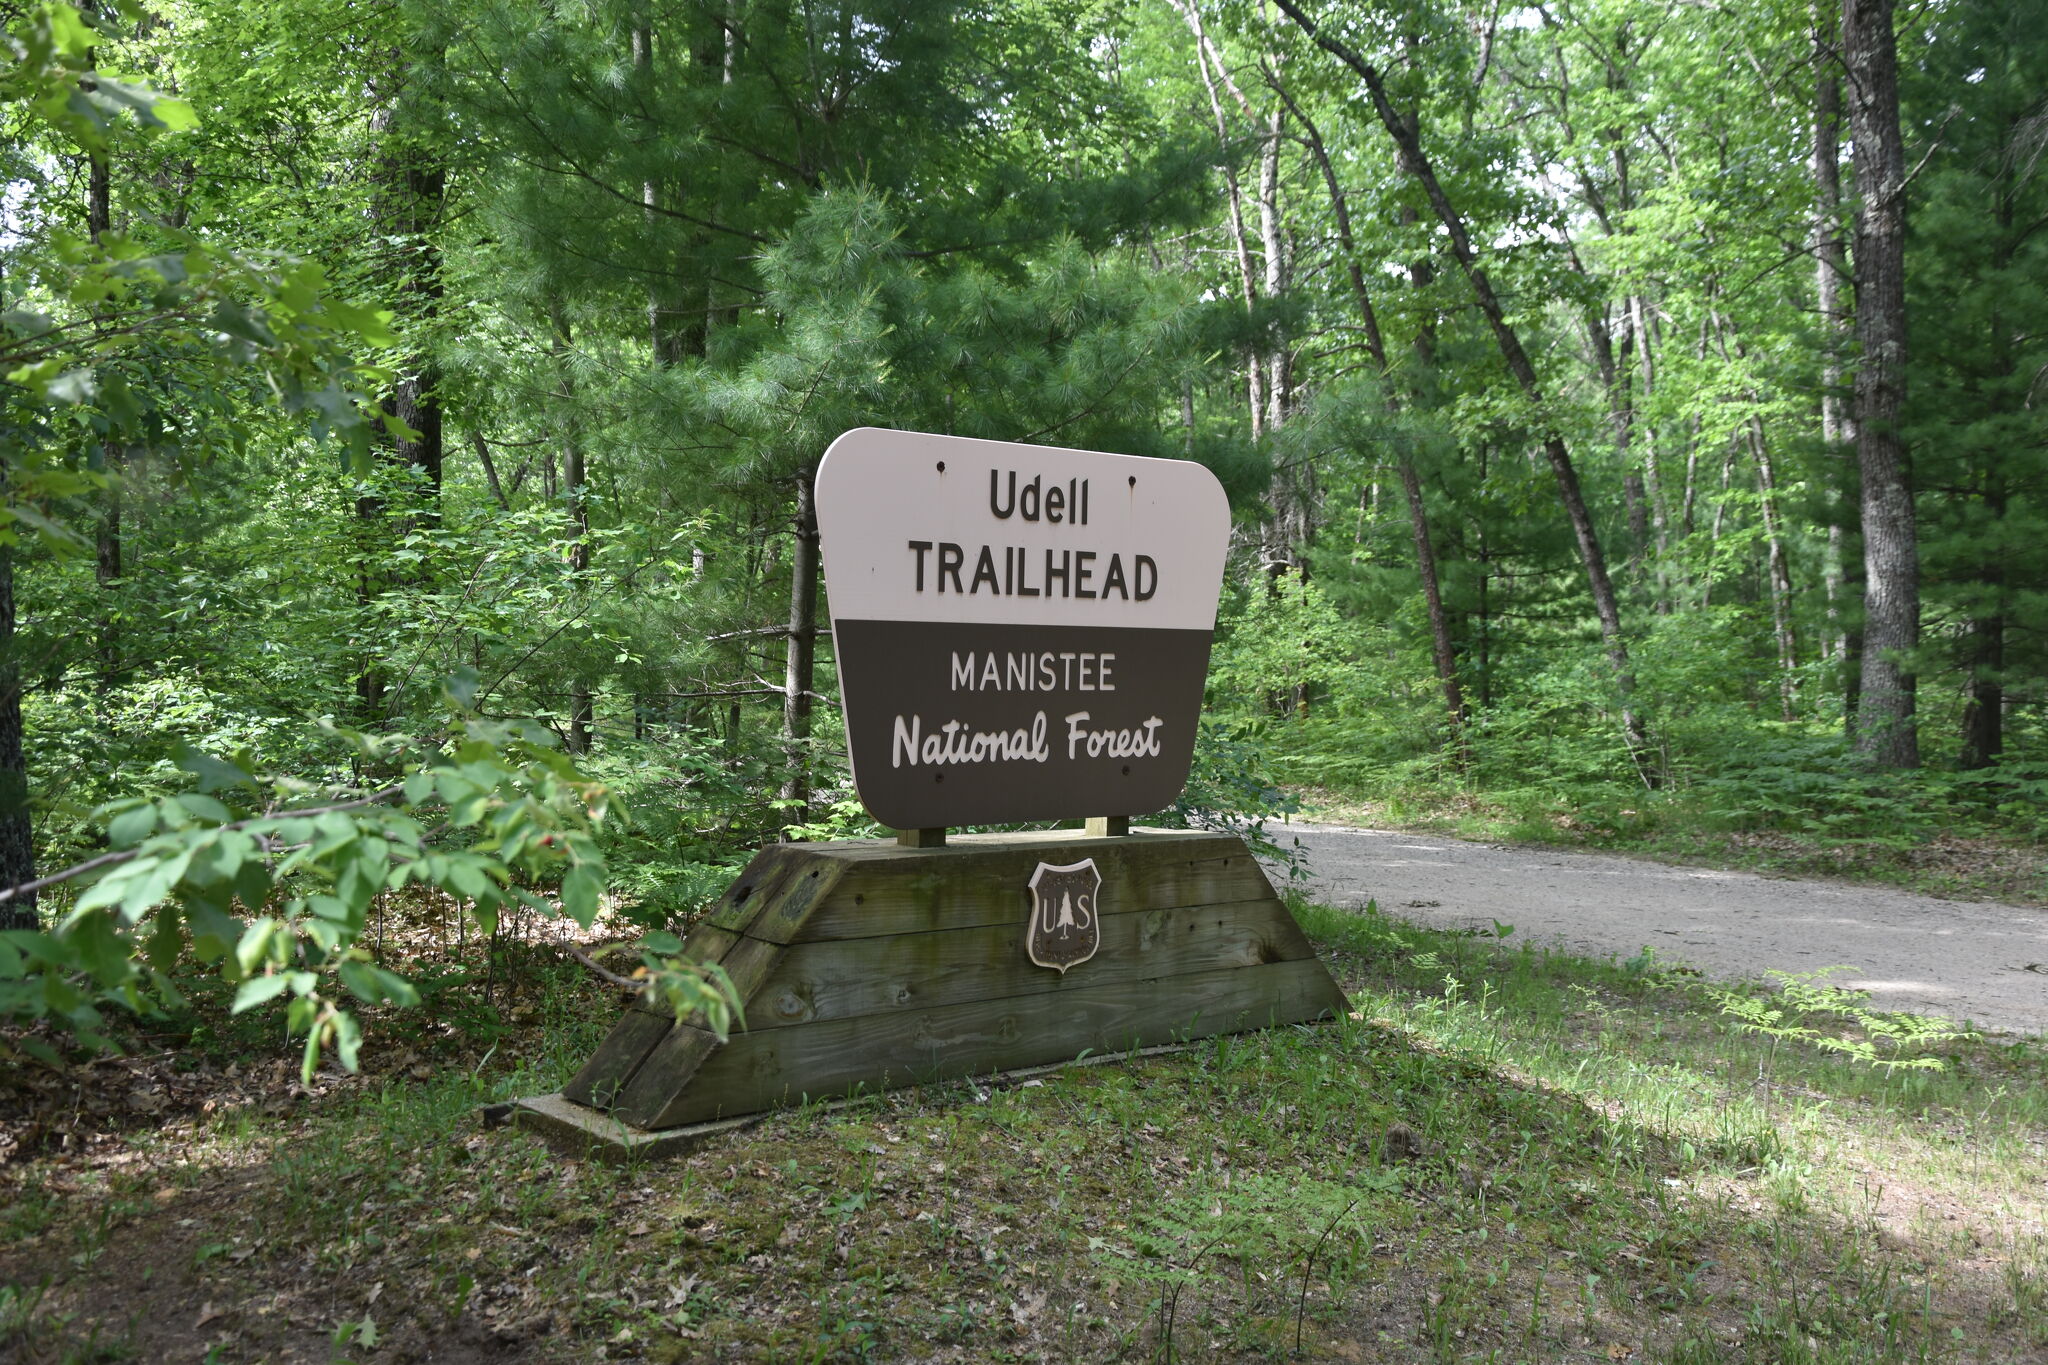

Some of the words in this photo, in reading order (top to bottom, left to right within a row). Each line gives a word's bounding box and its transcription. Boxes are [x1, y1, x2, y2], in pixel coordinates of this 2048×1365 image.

[990, 469, 1088, 525] Udell
[908, 540, 1158, 601] TRAILHEAD
[951, 651, 1116, 691] MANISTEE
[892, 710, 1049, 769] National
[1065, 711, 1163, 759] Forest
